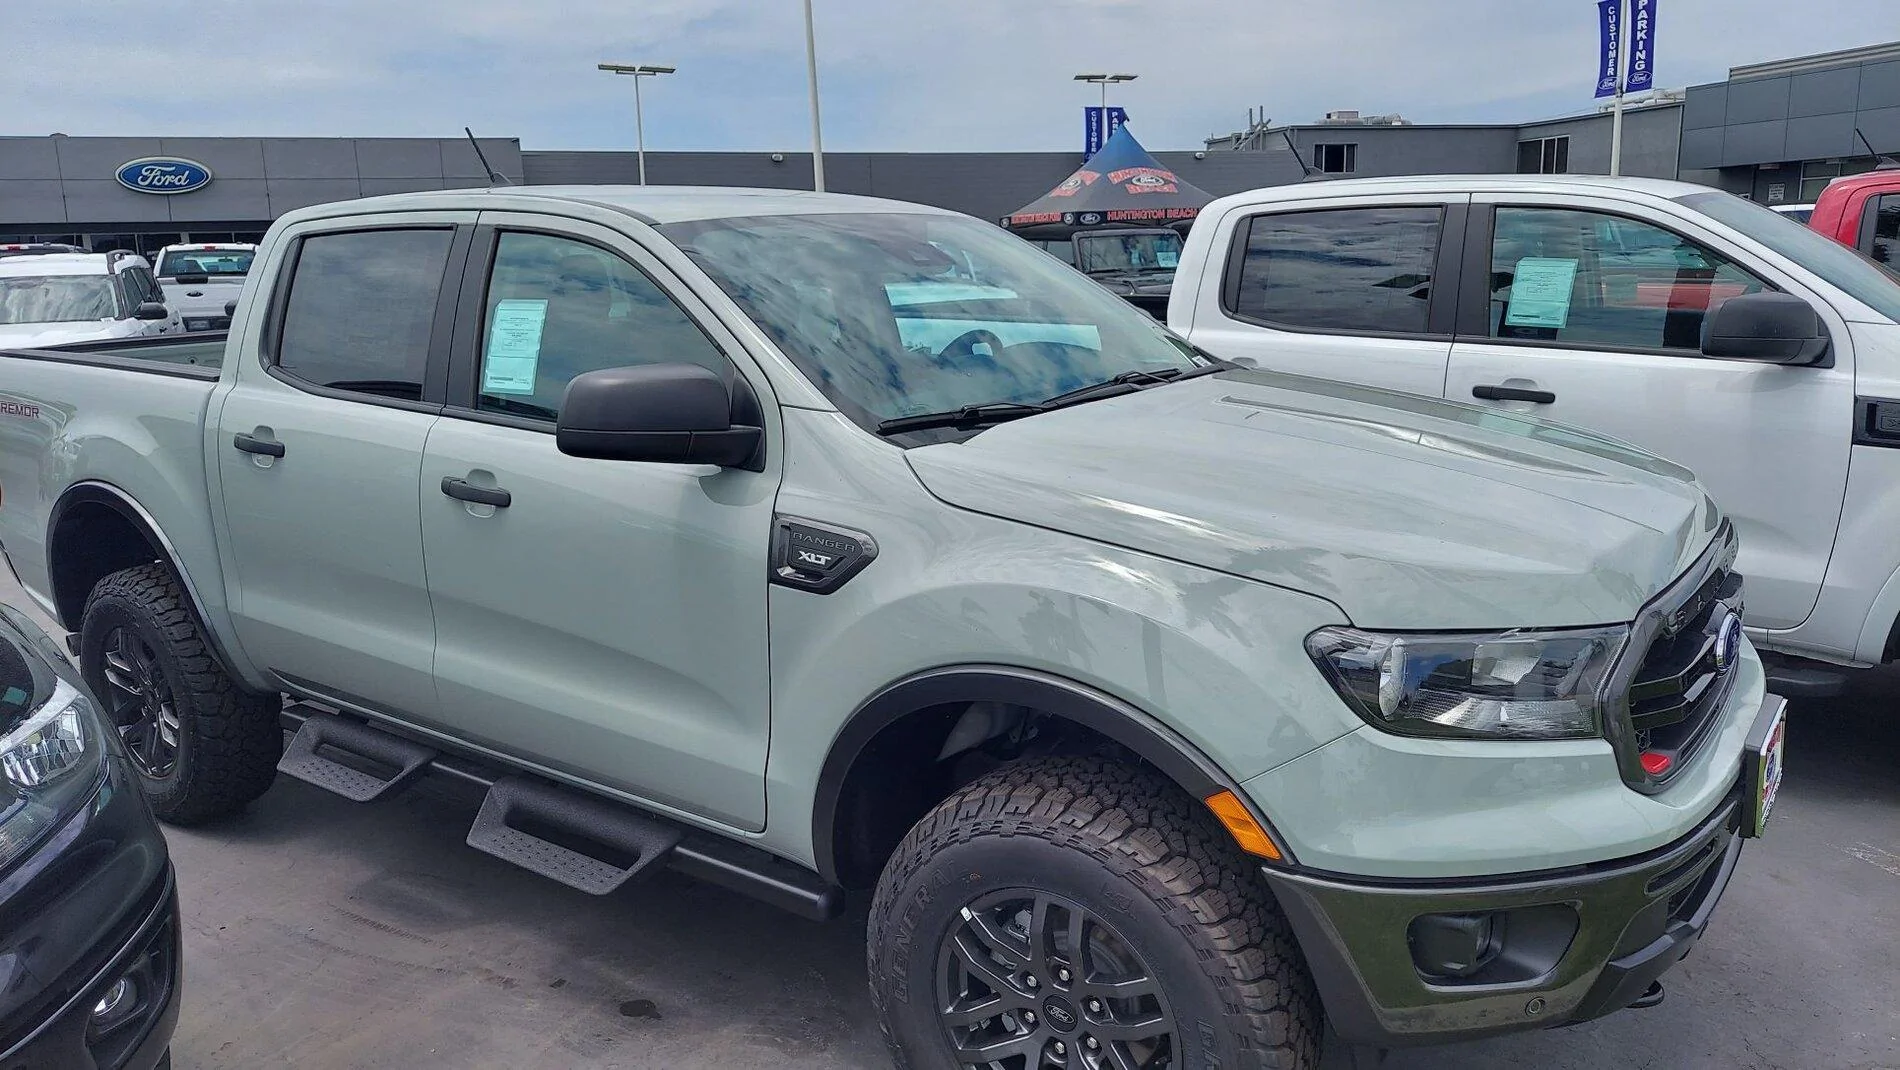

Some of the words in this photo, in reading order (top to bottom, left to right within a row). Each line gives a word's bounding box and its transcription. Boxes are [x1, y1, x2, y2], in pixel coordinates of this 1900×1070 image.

[1607, 6, 1617, 76] CUSTOMER
[1635, 0, 1648, 70] PARKING
[138, 165, 190, 186] Ford
[1107, 209, 1165, 220] HUNTINGTON
[1166, 207, 1198, 218] BEACH
[793, 532, 855, 552] RANGER
[798, 550, 831, 565] XLT
